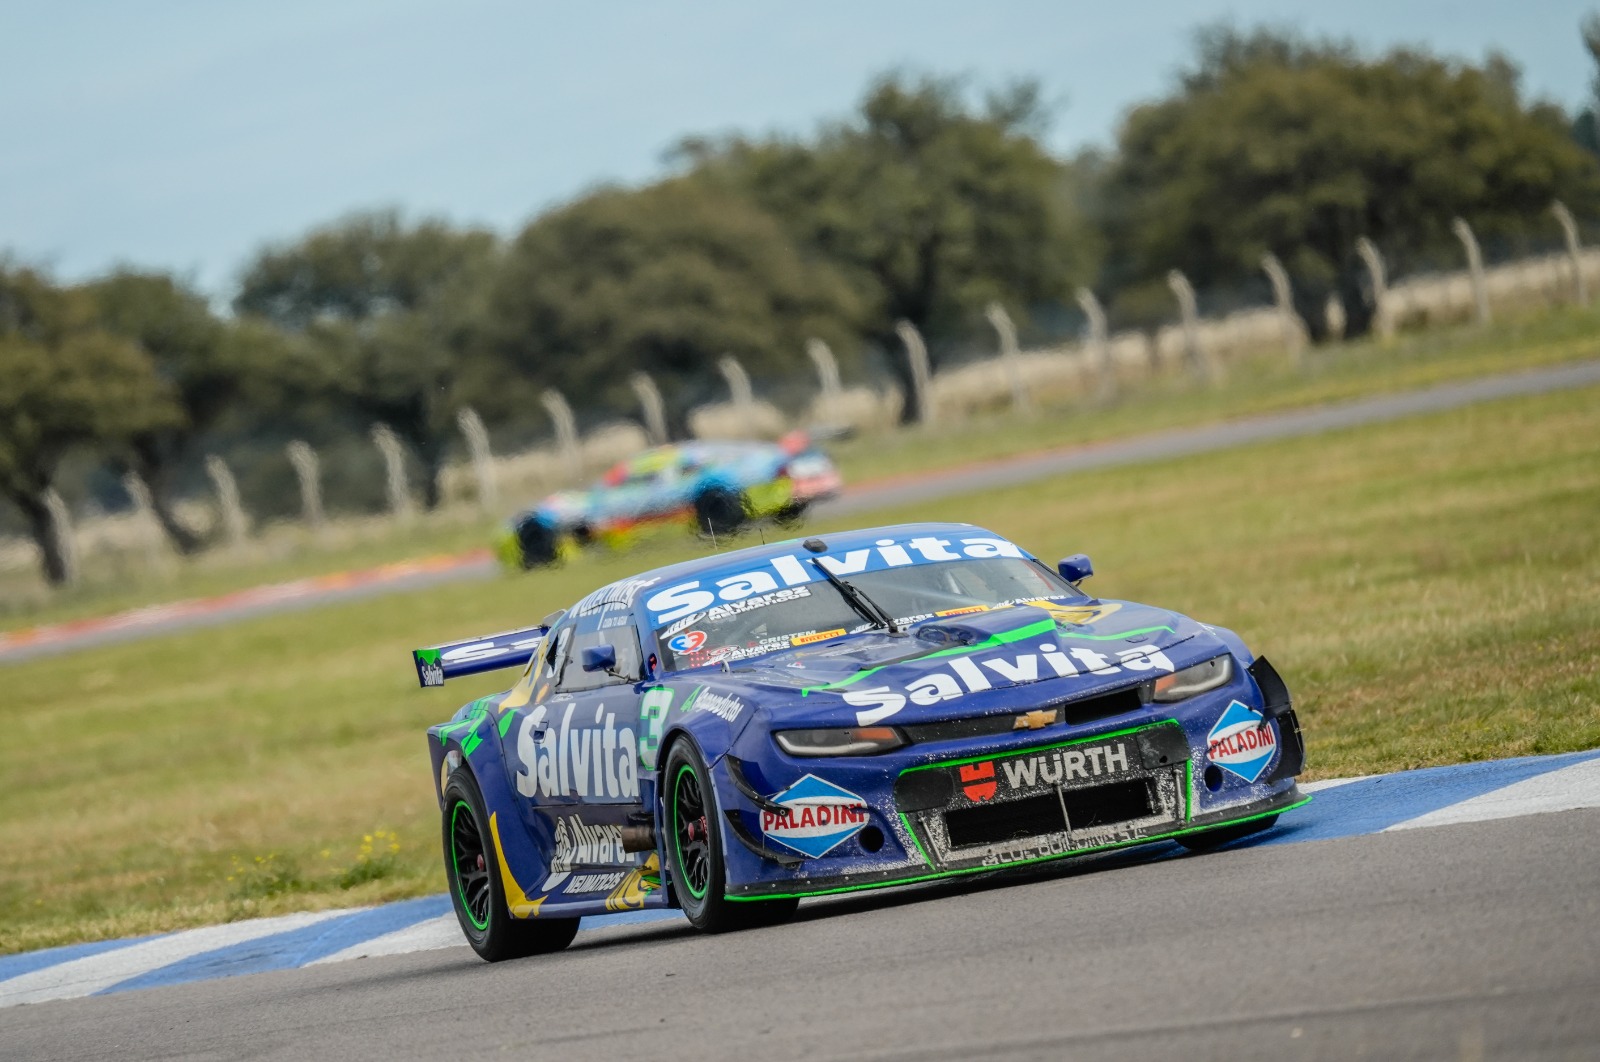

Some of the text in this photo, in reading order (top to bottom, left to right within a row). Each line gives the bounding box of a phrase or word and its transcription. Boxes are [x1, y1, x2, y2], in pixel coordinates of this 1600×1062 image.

[647, 537, 1023, 624] Salvita
[708, 585, 810, 615] Alvarez
[800, 631, 840, 643] PIRELLI
[421, 662, 444, 686] Salvita
[842, 643, 1175, 727] Salvita
[640, 686, 675, 771] 3
[1210, 724, 1274, 760] PALADINI
[516, 702, 639, 798] Salvita
[1002, 743, 1129, 789] WÜRTH
[763, 800, 868, 831] PALADINI
[569, 813, 635, 864] Alvare
[563, 871, 625, 894] NEUMATICOS
